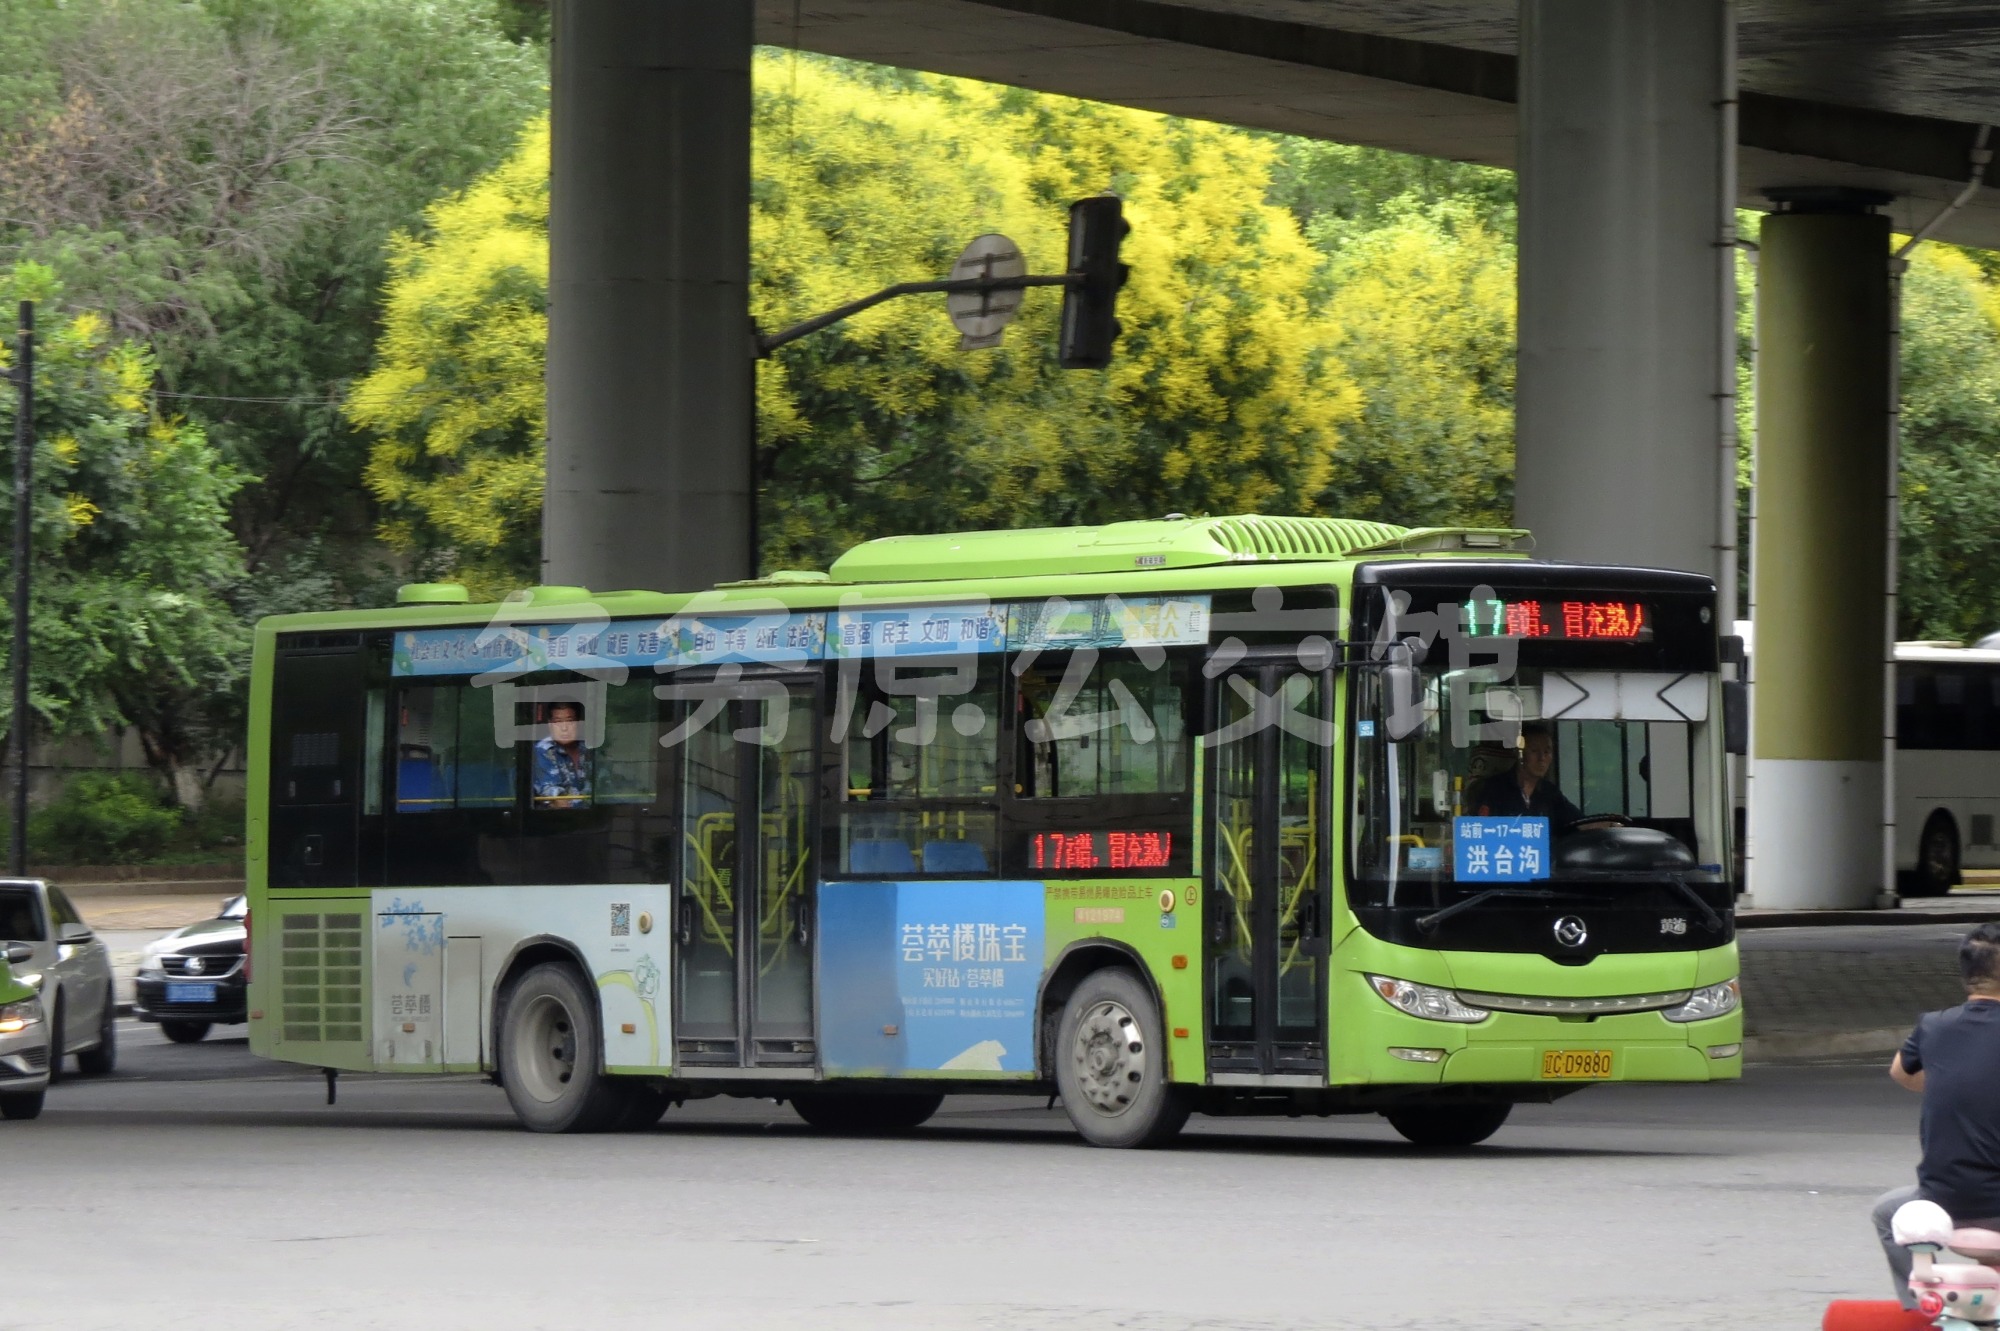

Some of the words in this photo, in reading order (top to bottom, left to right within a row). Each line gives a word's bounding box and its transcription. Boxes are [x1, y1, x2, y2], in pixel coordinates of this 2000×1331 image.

[606, 632, 630, 656] 诚信
[637, 631, 659, 655] 友善
[693, 629, 716, 651] 自由
[724, 628, 748, 651] 平等
[756, 627, 778, 649] 公正
[786, 626, 809, 648] 法治
[843, 622, 872, 646] 富强
[882, 621, 910, 644] 民主
[920, 619, 949, 643] 文明
[960, 616, 991, 641] 和谐
[1460, 822, 1483, 839] 站前
[1496, 824, 1509, 837] 17
[1522, 822, 1544, 839] 眼矿
[1035, 833, 1064, 869] 17
[1467, 844, 1540, 875] 洪台沟
[902, 923, 1027, 962] 荟萃楼珠宝
